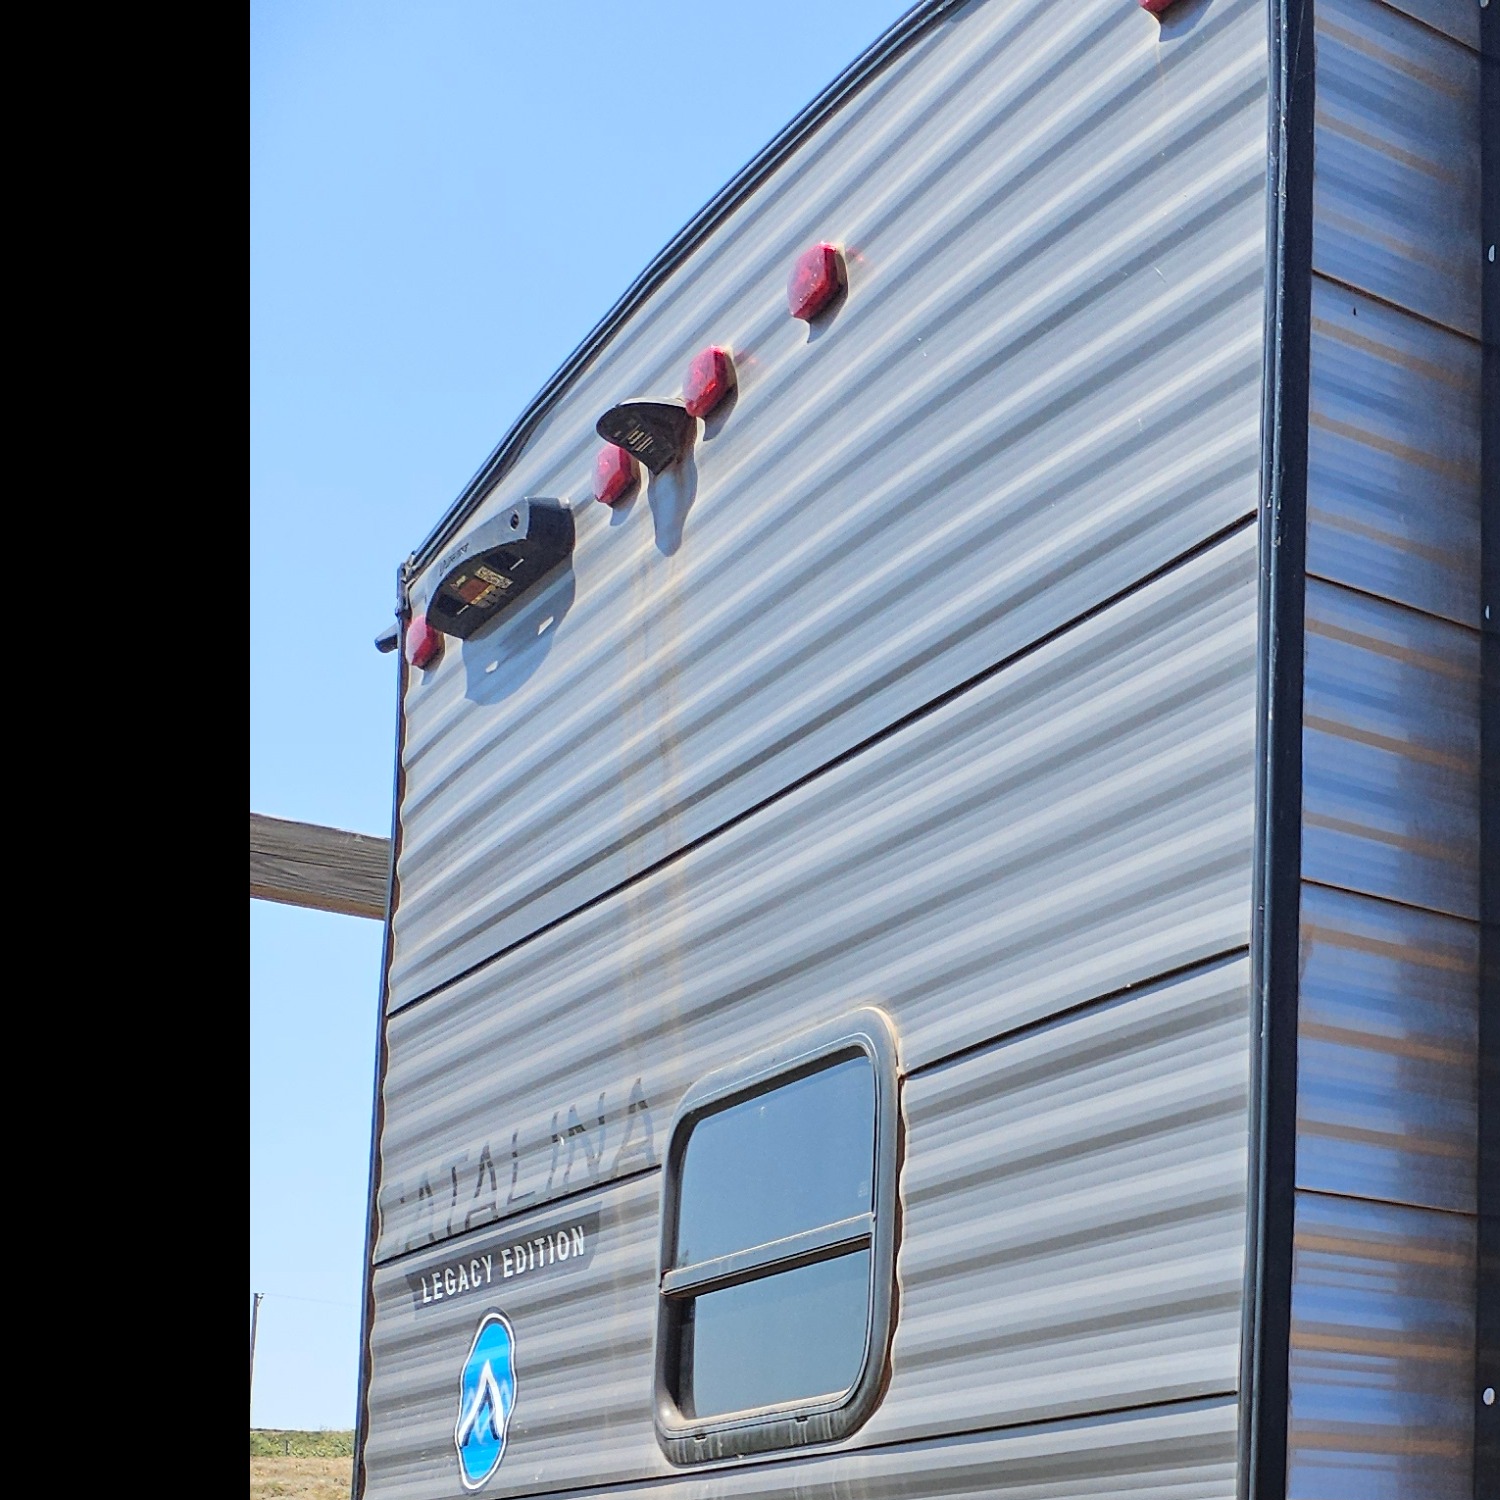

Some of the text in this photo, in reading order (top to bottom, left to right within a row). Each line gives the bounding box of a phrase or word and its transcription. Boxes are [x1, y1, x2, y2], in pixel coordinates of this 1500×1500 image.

[379, 1077, 657, 1258] ATALINA
[420, 1225, 585, 1304] LEGACY EDITION
